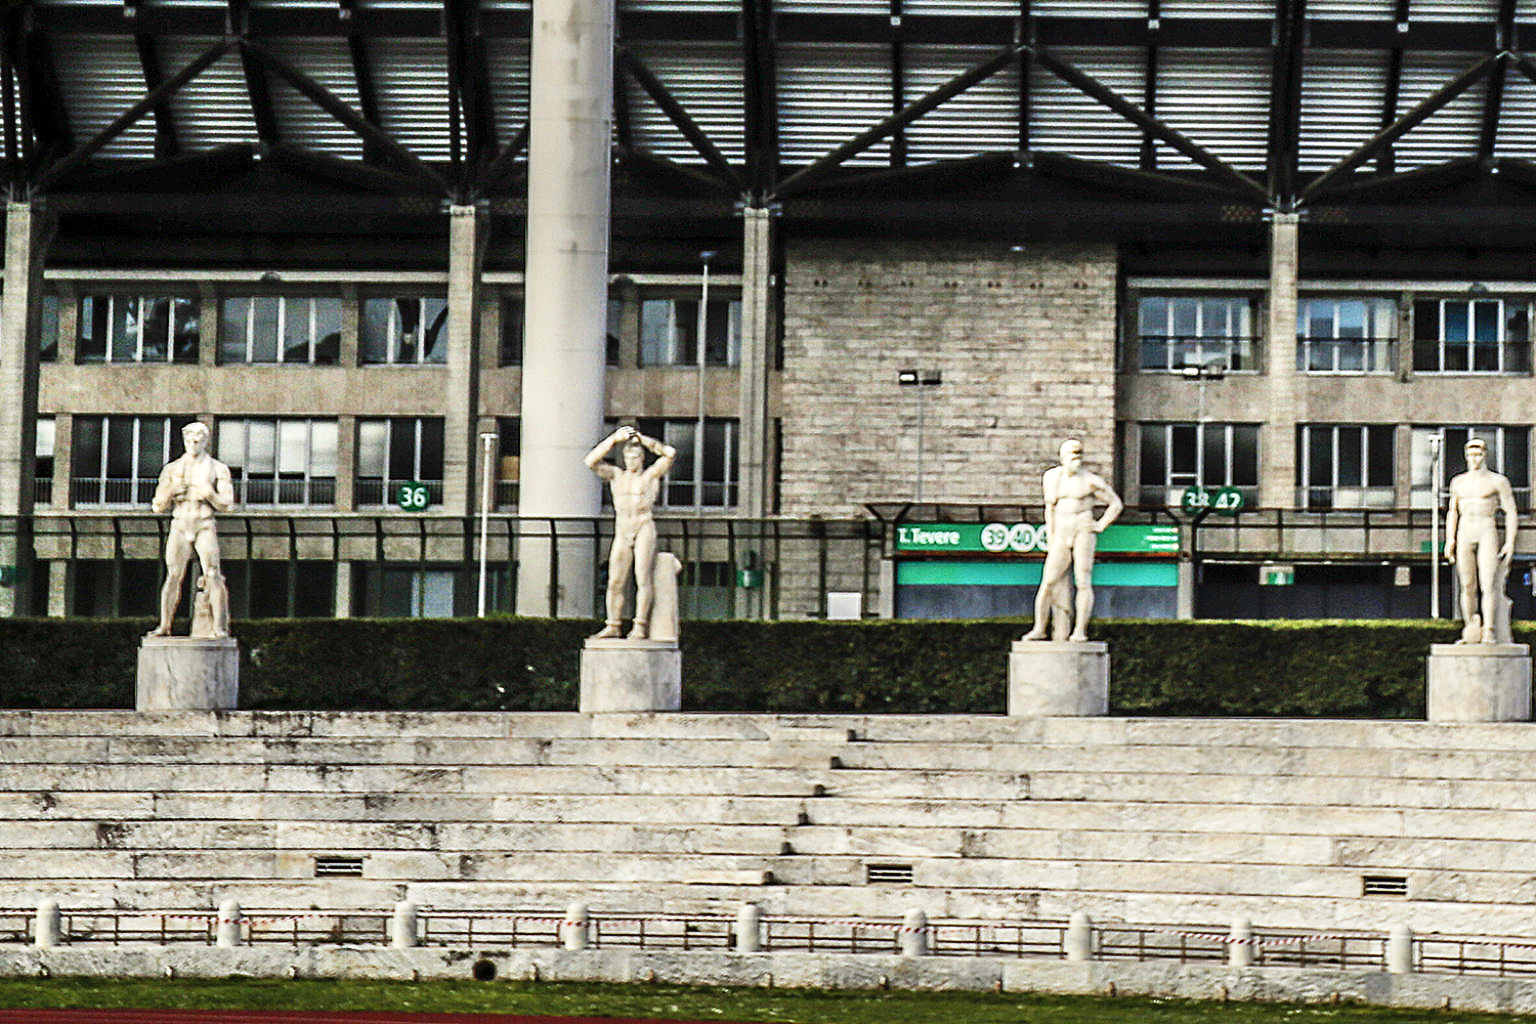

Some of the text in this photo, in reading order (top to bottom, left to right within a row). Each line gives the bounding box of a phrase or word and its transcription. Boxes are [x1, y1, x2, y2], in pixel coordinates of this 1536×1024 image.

[401, 487, 425, 507] 36
[987, 529, 1005, 545] 39
[1014, 529, 1032, 545] 40
